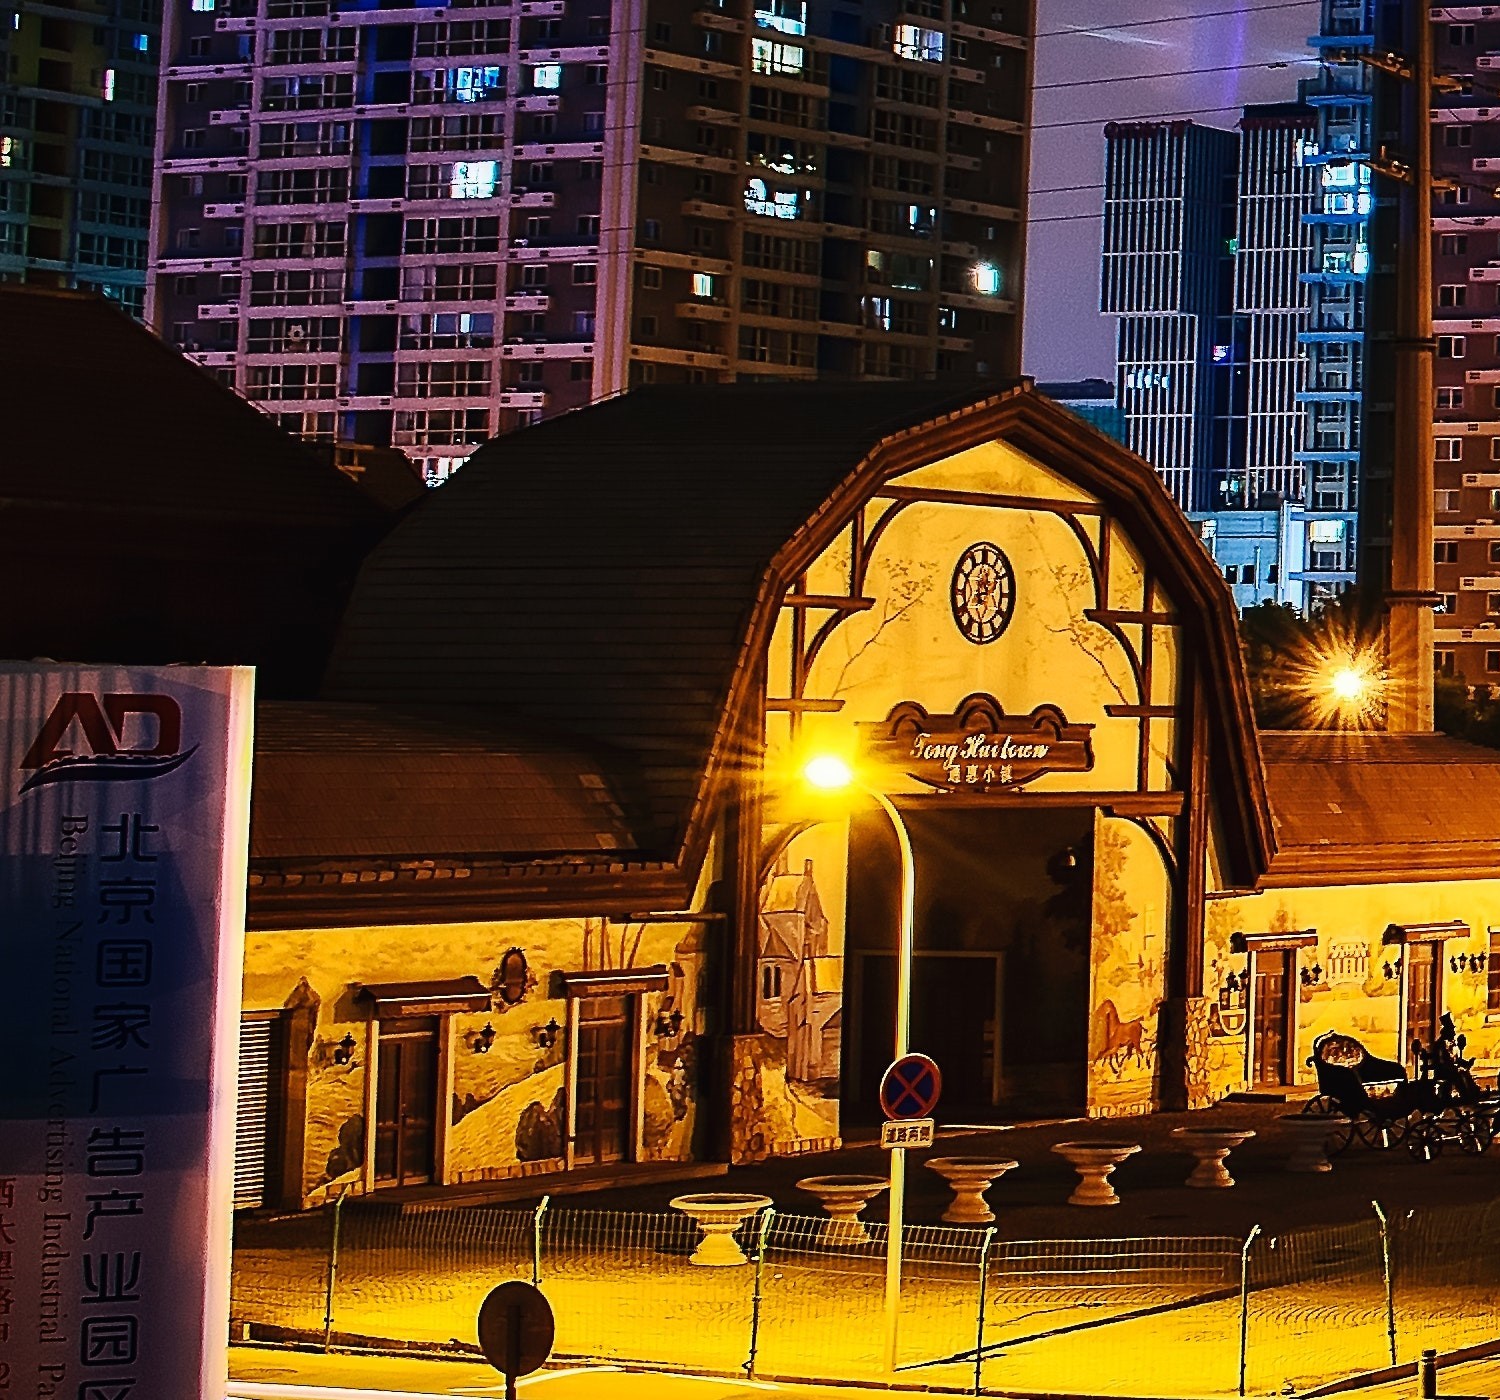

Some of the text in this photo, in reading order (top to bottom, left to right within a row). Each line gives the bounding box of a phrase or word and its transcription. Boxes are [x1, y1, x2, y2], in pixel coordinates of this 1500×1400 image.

[53, 815, 89, 909] Beijing
[50, 919, 84, 1036] National
[38, 1046, 76, 1203] Advertising
[39, 1213, 71, 1344] Industrial
